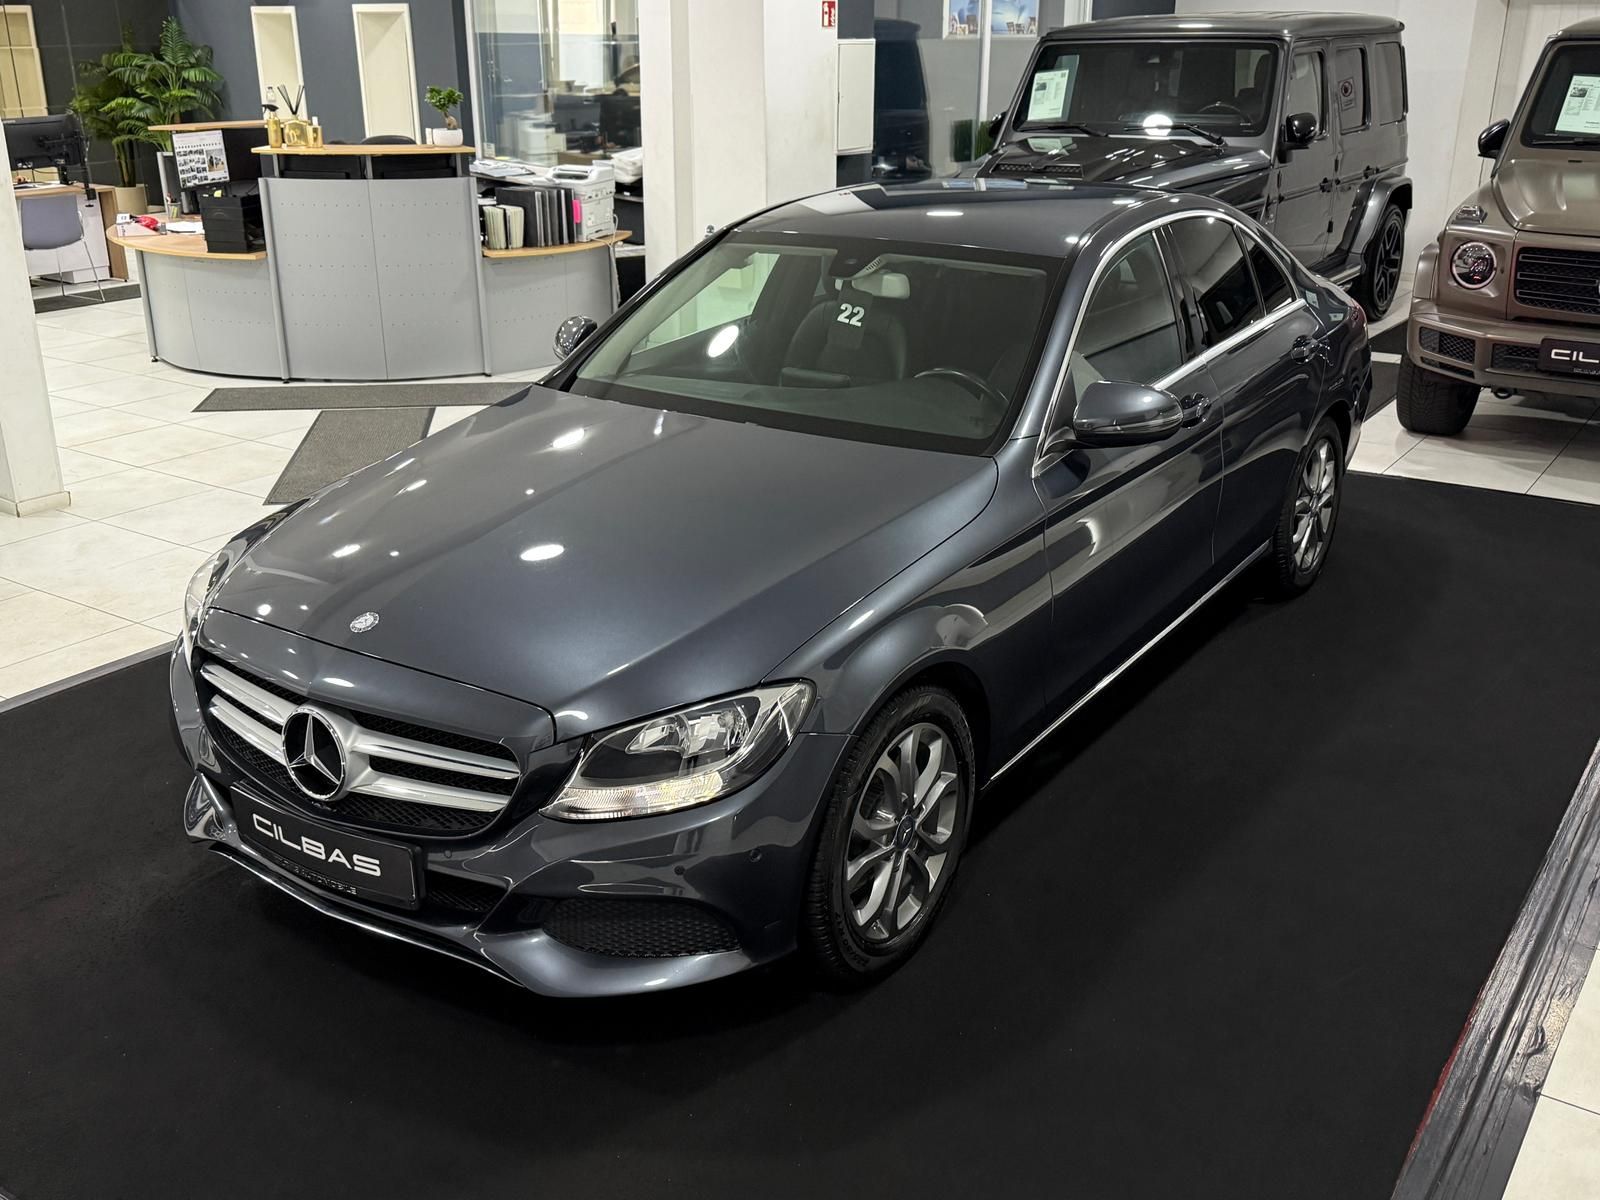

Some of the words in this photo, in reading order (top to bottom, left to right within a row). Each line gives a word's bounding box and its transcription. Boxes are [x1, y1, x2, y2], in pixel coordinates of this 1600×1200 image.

[837, 303, 865, 327] 22
[1551, 348, 1600, 363] CIL
[252, 813, 381, 877] CILBAS
